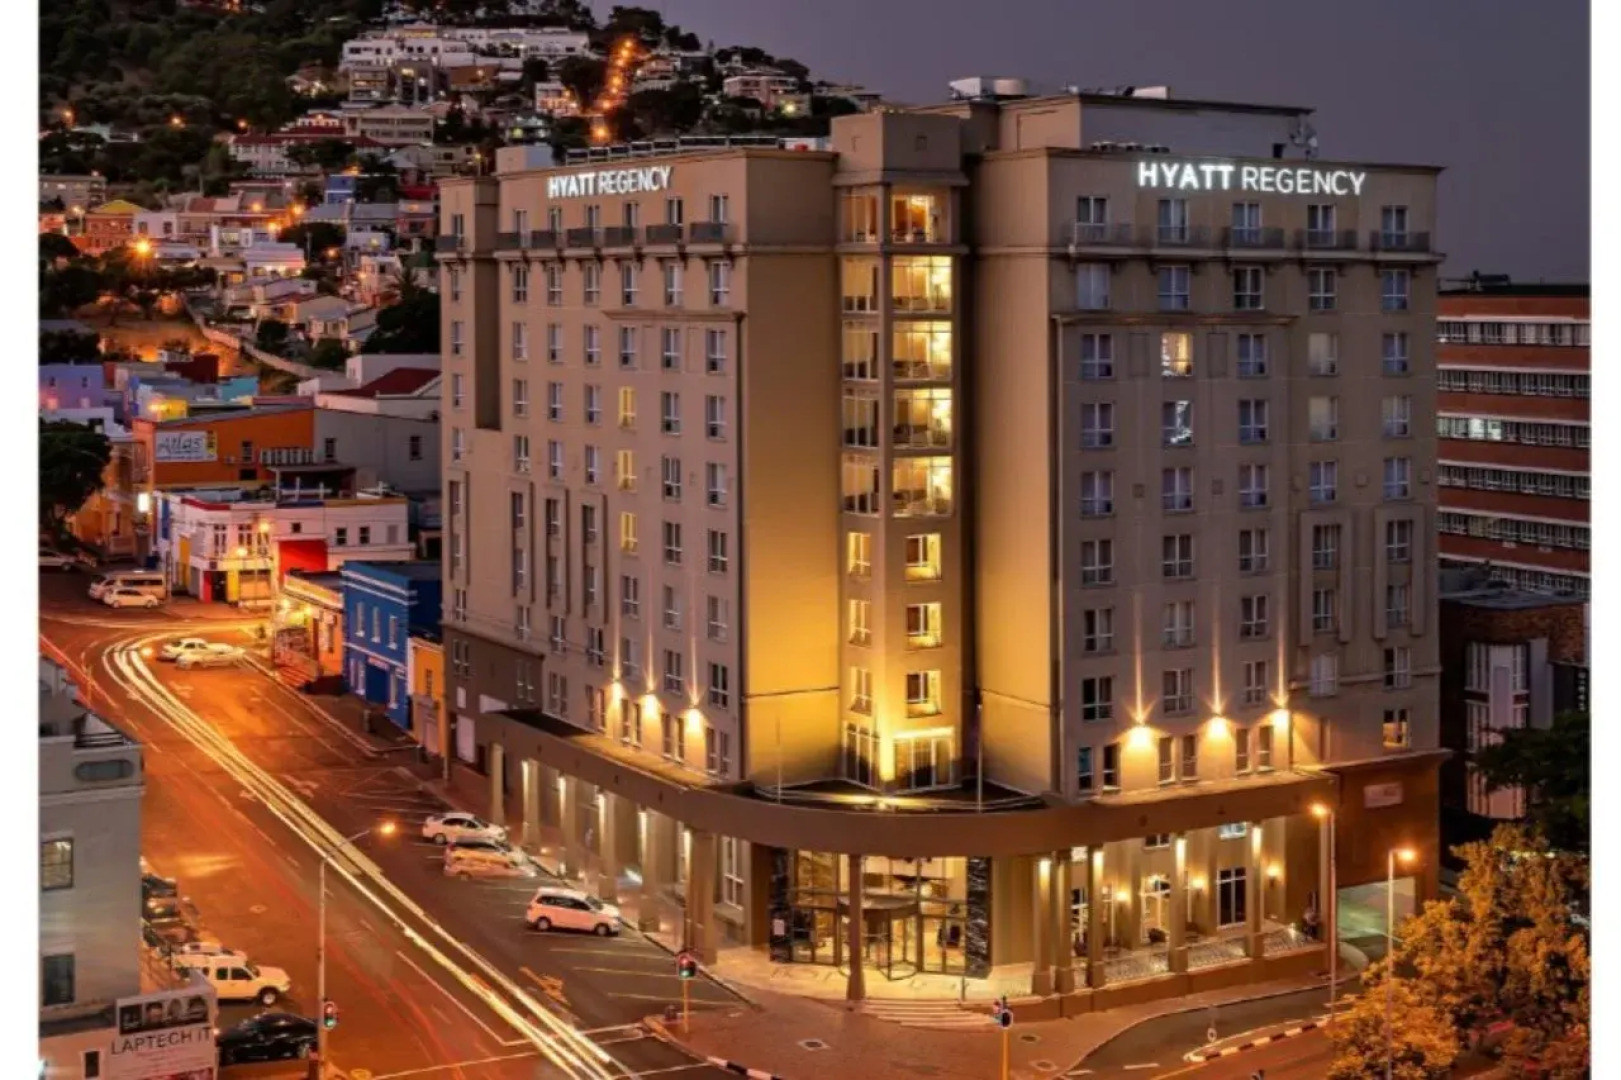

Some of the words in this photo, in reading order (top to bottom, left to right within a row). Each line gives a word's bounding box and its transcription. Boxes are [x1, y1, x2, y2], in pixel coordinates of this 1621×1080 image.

[547, 171, 596, 198] HYATT
[598, 165, 672, 194] REGENCY
[1138, 161, 1235, 190] HYATT
[1241, 166, 1366, 195] REGENCY
[110, 1029, 192, 1055] LAPTECH
